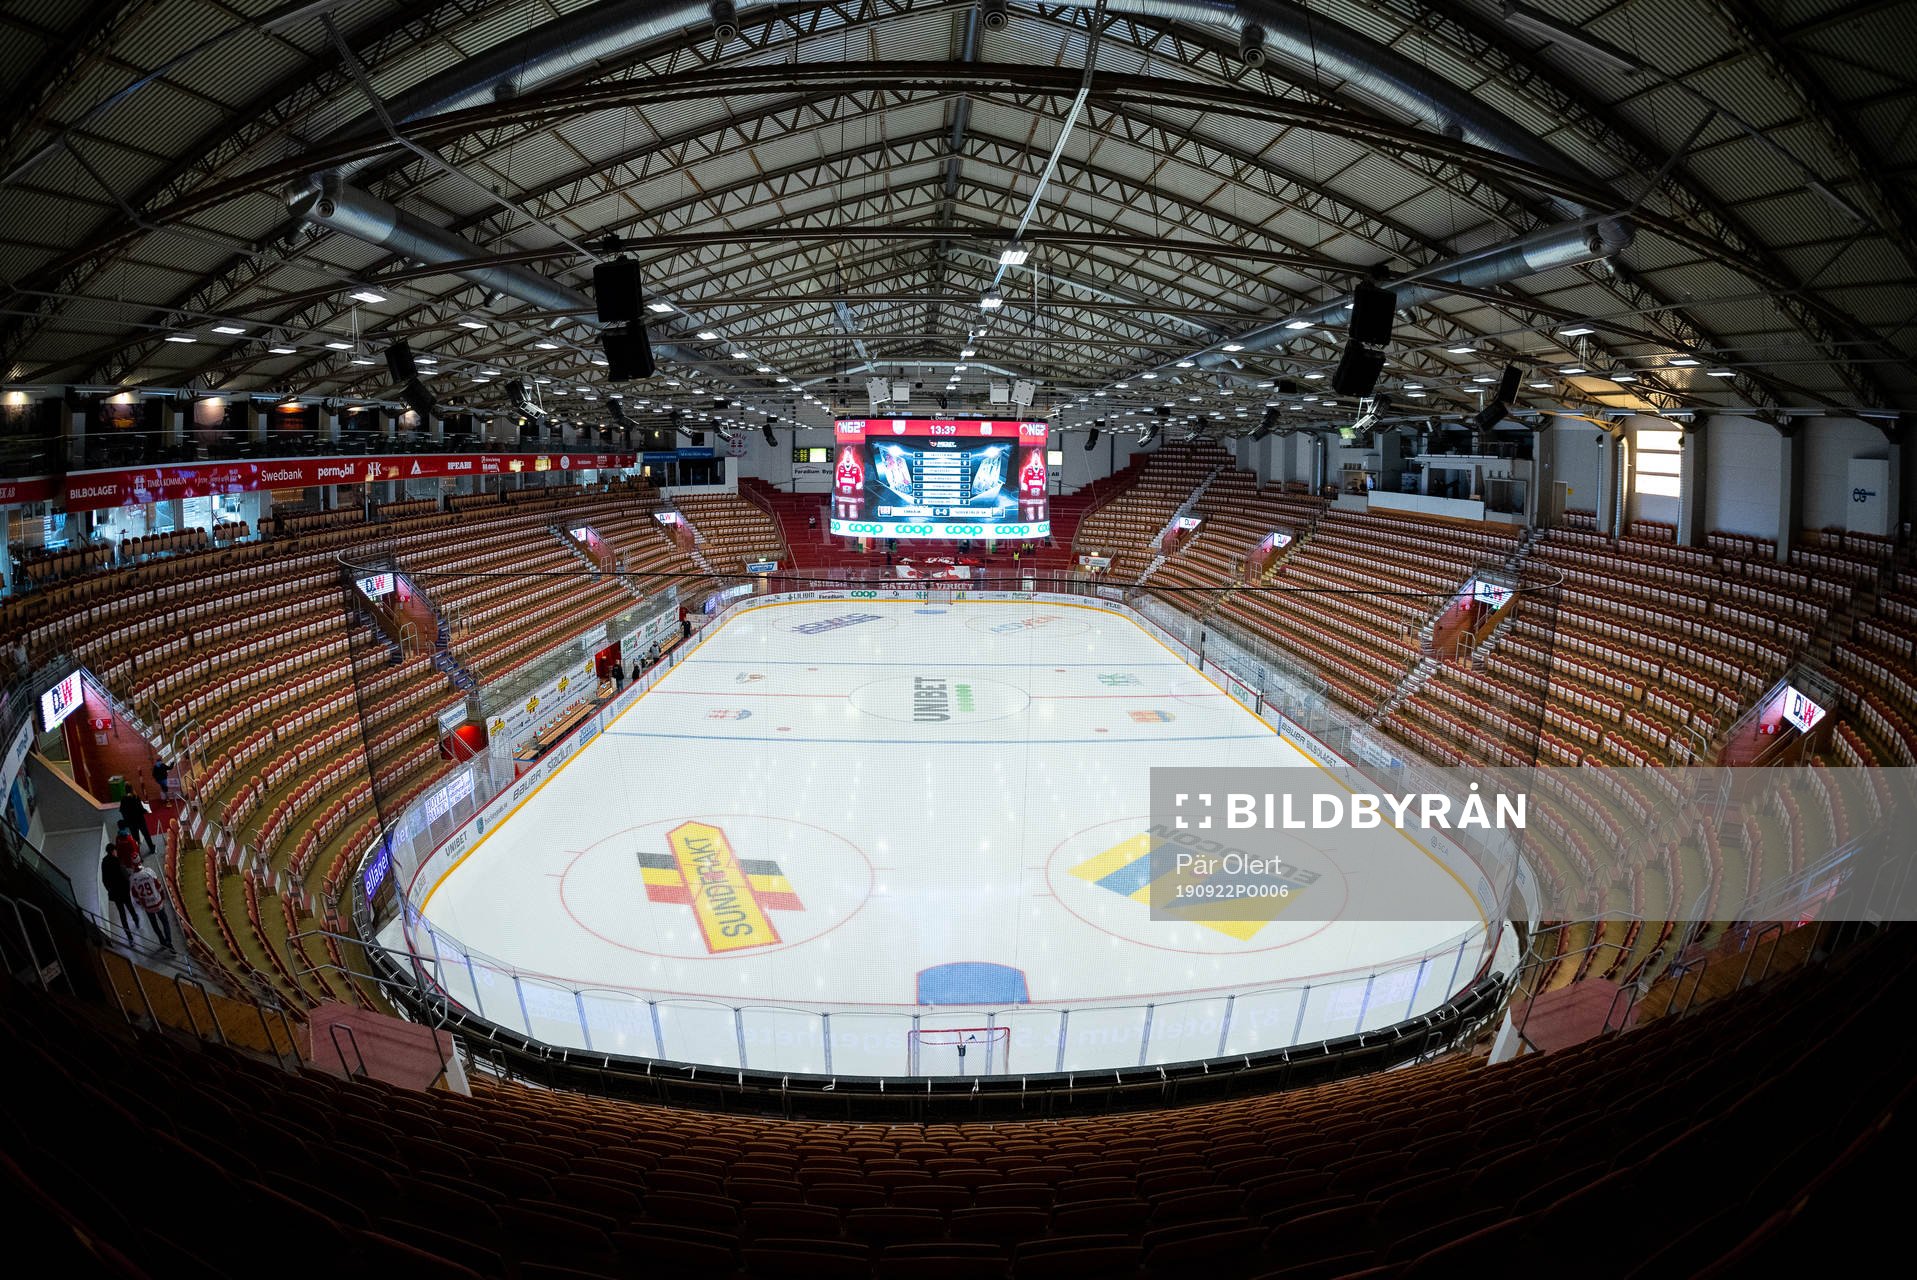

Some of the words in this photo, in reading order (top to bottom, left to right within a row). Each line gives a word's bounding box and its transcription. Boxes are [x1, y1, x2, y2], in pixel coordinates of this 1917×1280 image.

[930, 425, 956, 435] 13:39
[262, 468, 302, 482] Swedbank
[318, 463, 354, 480] permobil
[70, 484, 118, 499] BILBOLAGET
[848, 523, 883, 535] coop
[895, 525, 934, 536] coop
[945, 525, 983, 536] coop
[995, 525, 1030, 536] coop
[850, 590, 877, 599] coop
[913, 676, 951, 722] UNIBET
[1282, 722, 1306, 746] BAUER
[1306, 739, 1336, 768] BILBOLAGET
[512, 768, 542, 801] BAUER
[445, 830, 468, 857] UNIBET
[684, 836, 752, 937] SUNDFRAKT
